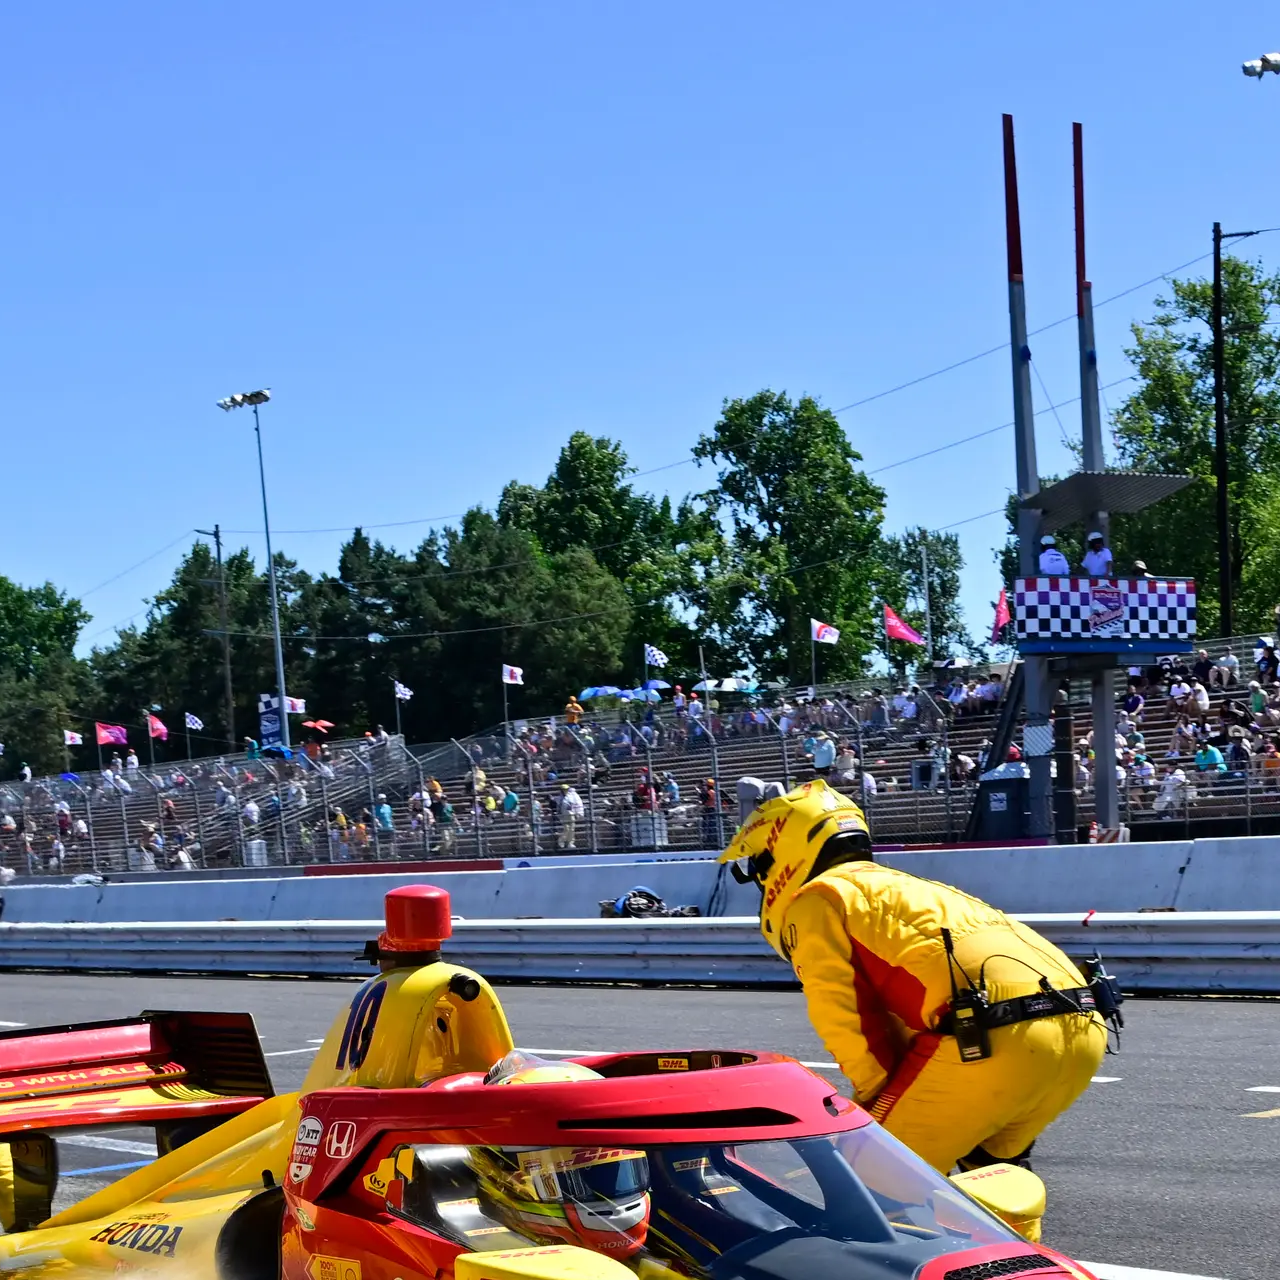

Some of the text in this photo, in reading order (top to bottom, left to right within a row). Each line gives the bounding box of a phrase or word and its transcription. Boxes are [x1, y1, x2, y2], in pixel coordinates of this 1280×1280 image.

[766, 863, 797, 908] DHL
[336, 980, 387, 1071] 10
[662, 1060, 685, 1069] DHL
[22, 1072, 87, 1086] WITH
[306, 1129, 320, 1139] NTT
[89, 1221, 184, 1258] HONDA
